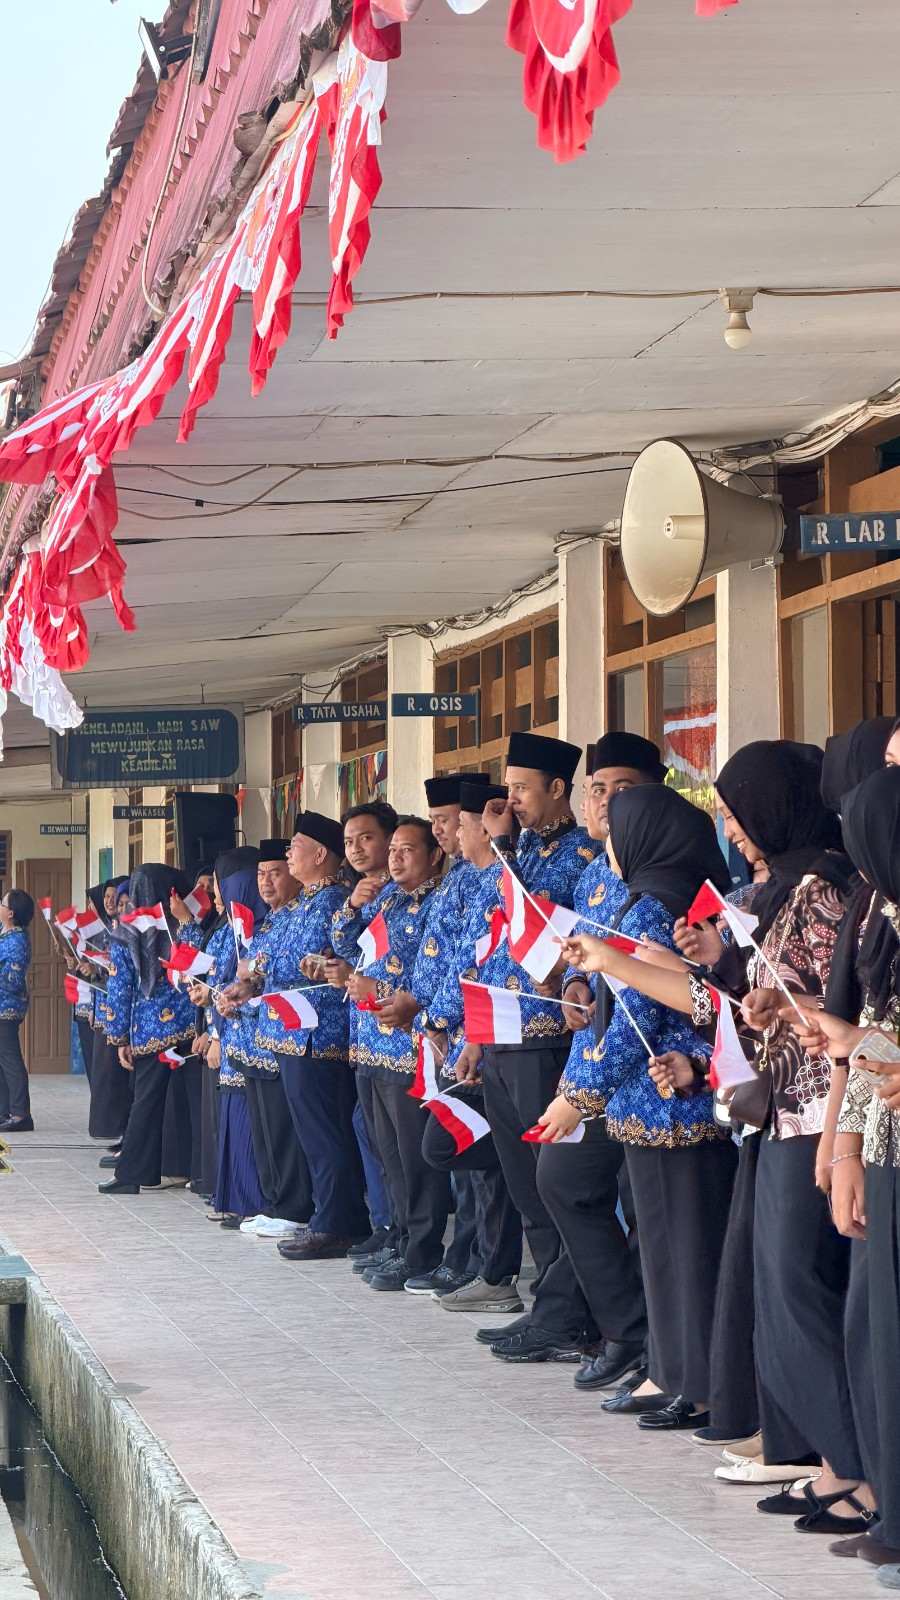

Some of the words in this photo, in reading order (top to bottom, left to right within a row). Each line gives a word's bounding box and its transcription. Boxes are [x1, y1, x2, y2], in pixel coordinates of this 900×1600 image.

[816, 521, 839, 545] R.
[844, 519, 886, 543] LAB
[407, 696, 422, 711] R.
[429, 697, 463, 711] OSIS
[310, 706, 337, 719] TATA
[343, 704, 380, 717] USAHA
[157, 720, 183, 732] NABI
[191, 718, 220, 731] SAW
[91, 739, 172, 753] MEWUJUDKAN
[177, 738, 206, 750] RASA
[121, 758, 176, 772] KEADILAN
[131, 807, 166, 817] WAKASEK
